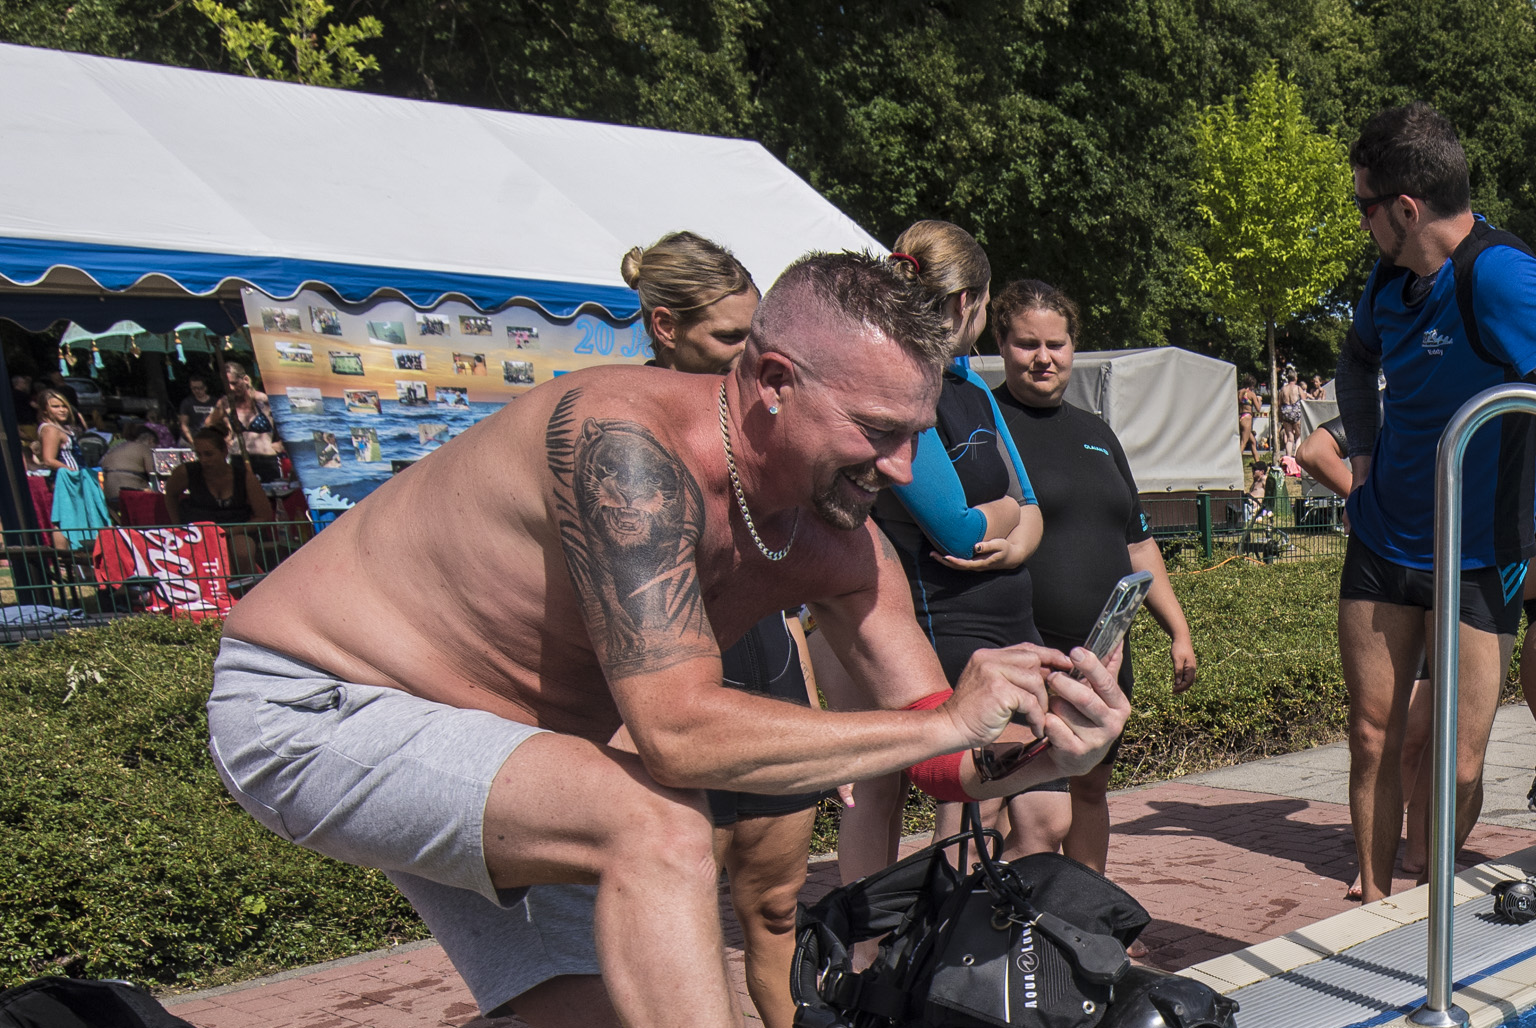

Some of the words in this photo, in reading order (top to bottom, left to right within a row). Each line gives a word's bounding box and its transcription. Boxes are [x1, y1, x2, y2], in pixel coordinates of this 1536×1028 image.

[574, 319, 615, 356] 20
[201, 556, 226, 601] Trn
[1023, 973, 1038, 1009] AQUA
